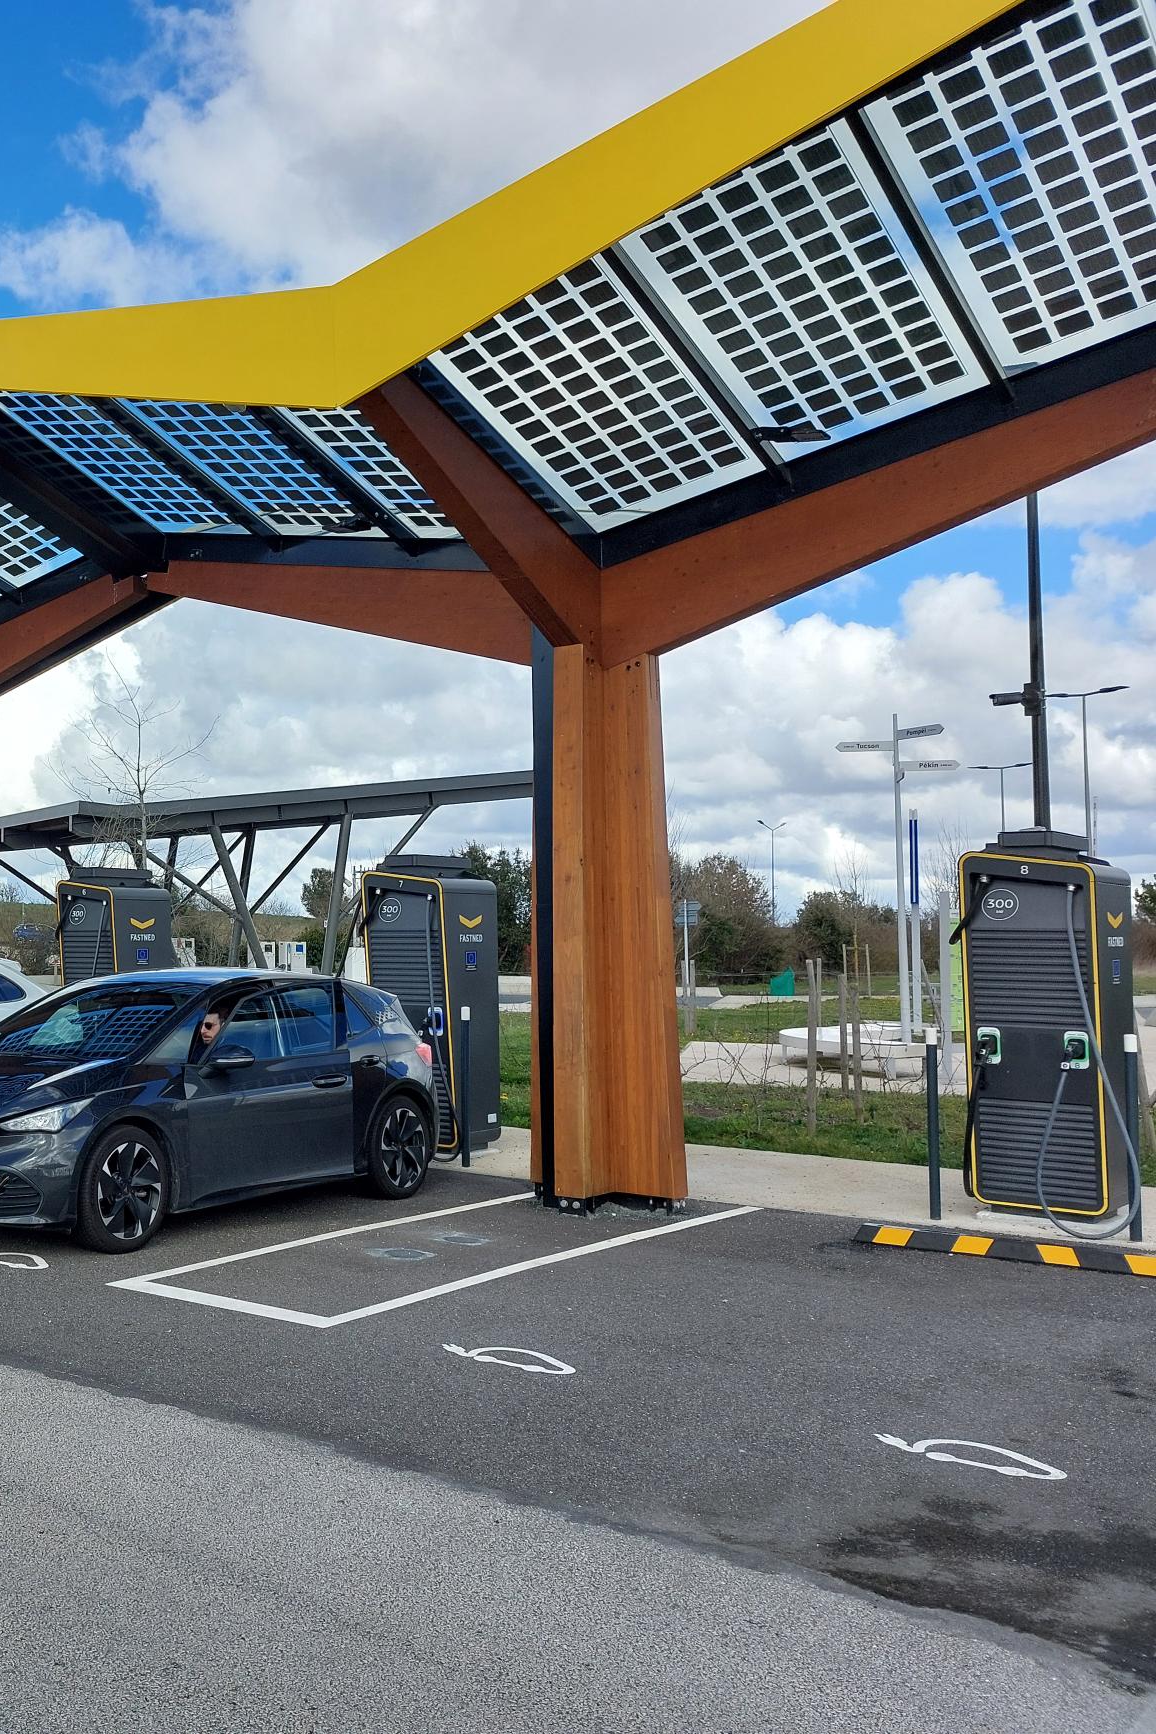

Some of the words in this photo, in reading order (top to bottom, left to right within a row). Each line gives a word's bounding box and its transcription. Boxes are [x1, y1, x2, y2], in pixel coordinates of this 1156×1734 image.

[1020, 865, 1029, 875] 8
[398, 880, 404, 888] 7
[986, 898, 1014, 909] 300
[71, 910, 84, 918] 300
[381, 905, 399, 914] 300
[130, 933, 156, 942] FASTNED
[459, 934, 483, 943] FASTNED
